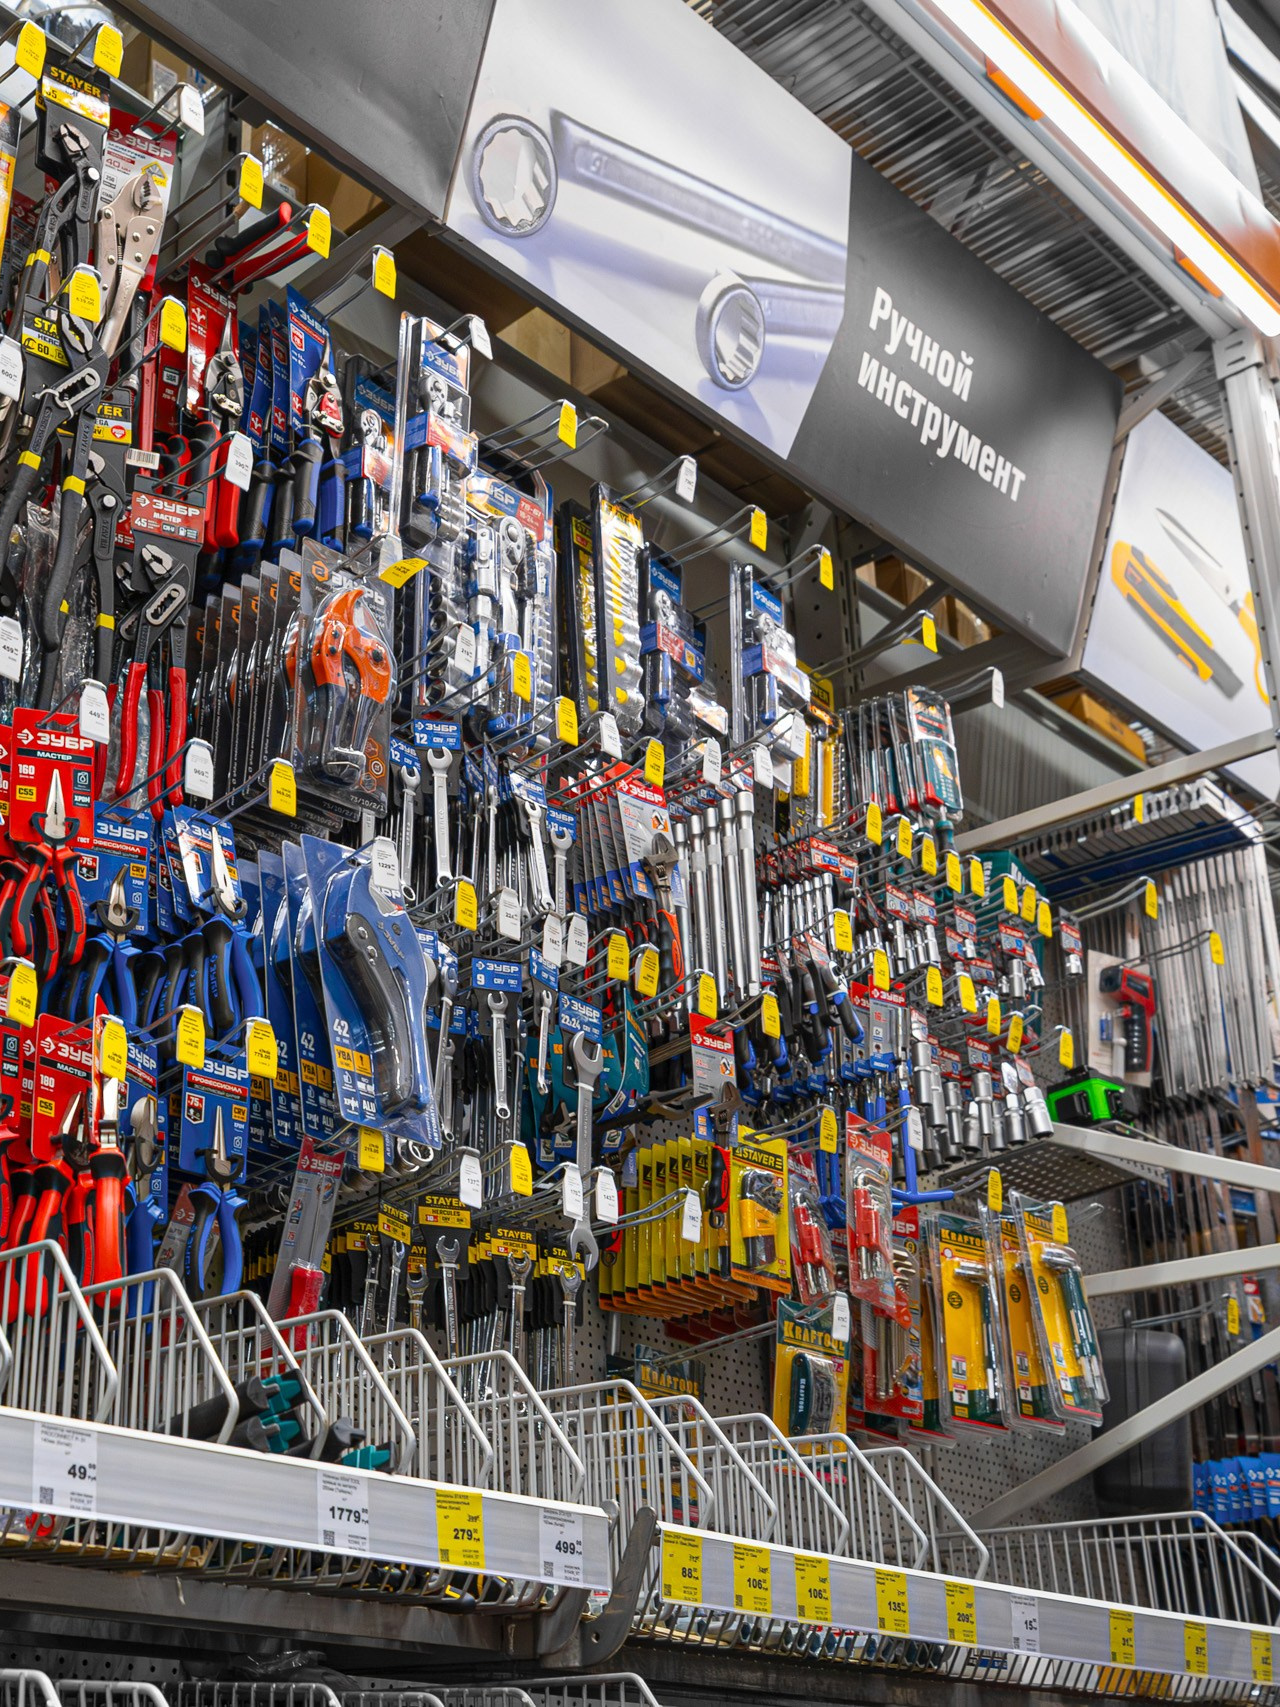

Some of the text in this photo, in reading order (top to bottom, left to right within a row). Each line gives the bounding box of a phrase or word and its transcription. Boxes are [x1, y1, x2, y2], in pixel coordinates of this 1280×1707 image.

[51, 66, 101, 98] STAYER
[122, 133, 173, 159] ЗУБР
[202, 283, 236, 309] ЗУБР
[299, 306, 330, 336] ЗУБР
[37, 341, 51, 355] 60
[869, 286, 973, 402] Ручной
[367, 389, 395, 412] ЗУБР
[858, 351, 1026, 502] инструмент
[152, 499, 201, 517] ЗУБР
[135, 516, 147, 527] 45
[154, 512, 181, 523] МАСТЕР
[660, 569, 679, 592] ЗУБР
[426, 722, 457, 733] ЗУБР
[37, 734, 94, 749] ЗУБР
[416, 734, 427, 745] 12
[37, 751, 72, 762] МАСТЕР
[18, 764, 35, 776] 160
[18, 787, 34, 797] C55
[74, 795, 91, 803] ХРОМ
[629, 786, 663, 803] ЗУБР
[552, 811, 575, 822] ЗУБР
[97, 823, 149, 841] ЗУБР
[132, 865, 145, 874] CRV
[487, 962, 519, 973] ЗУБР
[477, 974, 484, 984] 9
[880, 990, 905, 1005] ЗУБР
[571, 999, 600, 1018] ЗУБР
[333, 1018, 349, 1036] 42
[333, 1019, 349, 1036] 42
[301, 1032, 315, 1049] 42
[703, 1036, 731, 1050] ЗУБР
[58, 1044, 92, 1065] ЗУБ
[128, 1046, 156, 1069] ЗУБР
[57, 1063, 86, 1077] МАСТЕР
[201, 1064, 249, 1079] ЗУБР
[40, 1075, 55, 1088] 180
[191, 1077, 242, 1093] ПРОФЕССИОНАЛ
[38, 1100, 53, 1112] C55
[234, 1107, 245, 1117] CRV
[860, 1138, 889, 1159] ЗУБР
[310, 1158, 341, 1170] ЗУБР
[742, 1149, 777, 1168] STAYER
[425, 1195, 466, 1207] STAYER
[383, 1204, 409, 1222] STAYER
[497, 1229, 533, 1241] STAYER
[942, 1229, 986, 1246] KRAFTO
[641, 1365, 699, 1395] KRAFTOOL
[68, 1464, 87, 1479] 49
[329, 1506, 361, 1523] 1779
[454, 1528, 473, 1540] 279
[555, 1540, 576, 1554] 499
[682, 1567, 692, 1578] 88
[747, 1578, 762, 1588] 106
[808, 1588, 822, 1598] 106
[888, 1601, 901, 1611] 135
[957, 1613, 969, 1623] 209
[1024, 1620, 1033, 1630] 15
